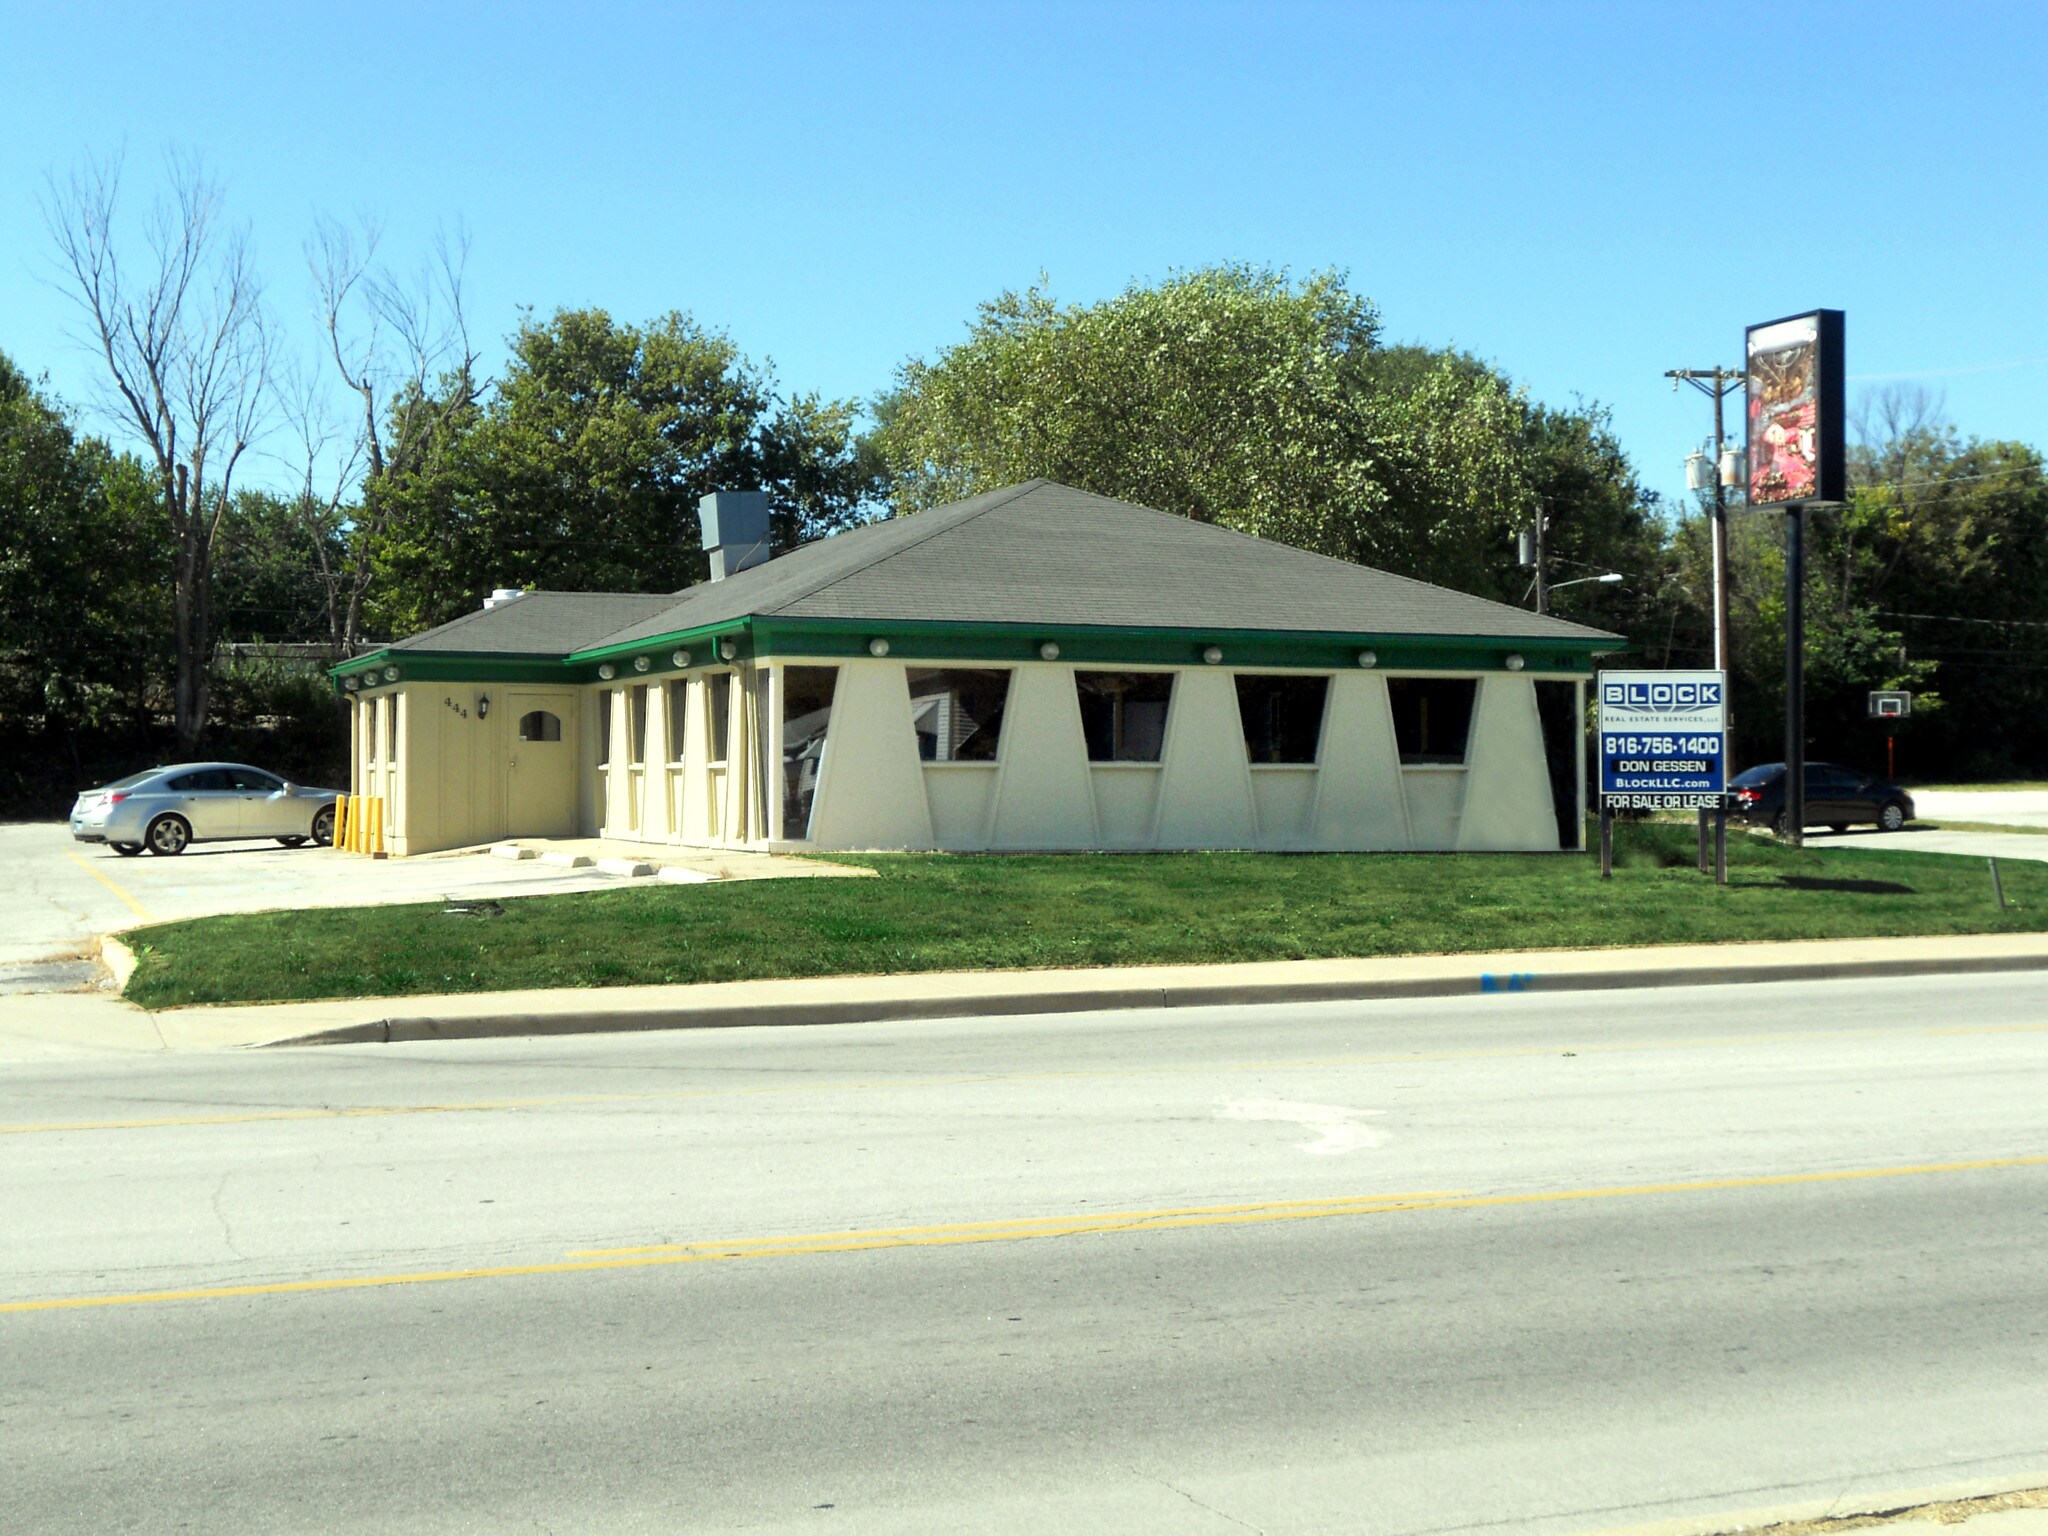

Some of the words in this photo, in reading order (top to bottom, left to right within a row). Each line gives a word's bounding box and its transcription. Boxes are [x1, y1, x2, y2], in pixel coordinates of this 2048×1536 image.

[1606, 686, 1718, 702] BLOCK
[444, 697, 467, 718] 444
[1619, 761, 1650, 772] DON
[1653, 761, 1706, 772] GESSEN
[1606, 795, 1630, 808] FOR
[1632, 795, 1662, 808] SALE
[1663, 795, 1681, 808] OR
[1683, 795, 1720, 808] LEASE
